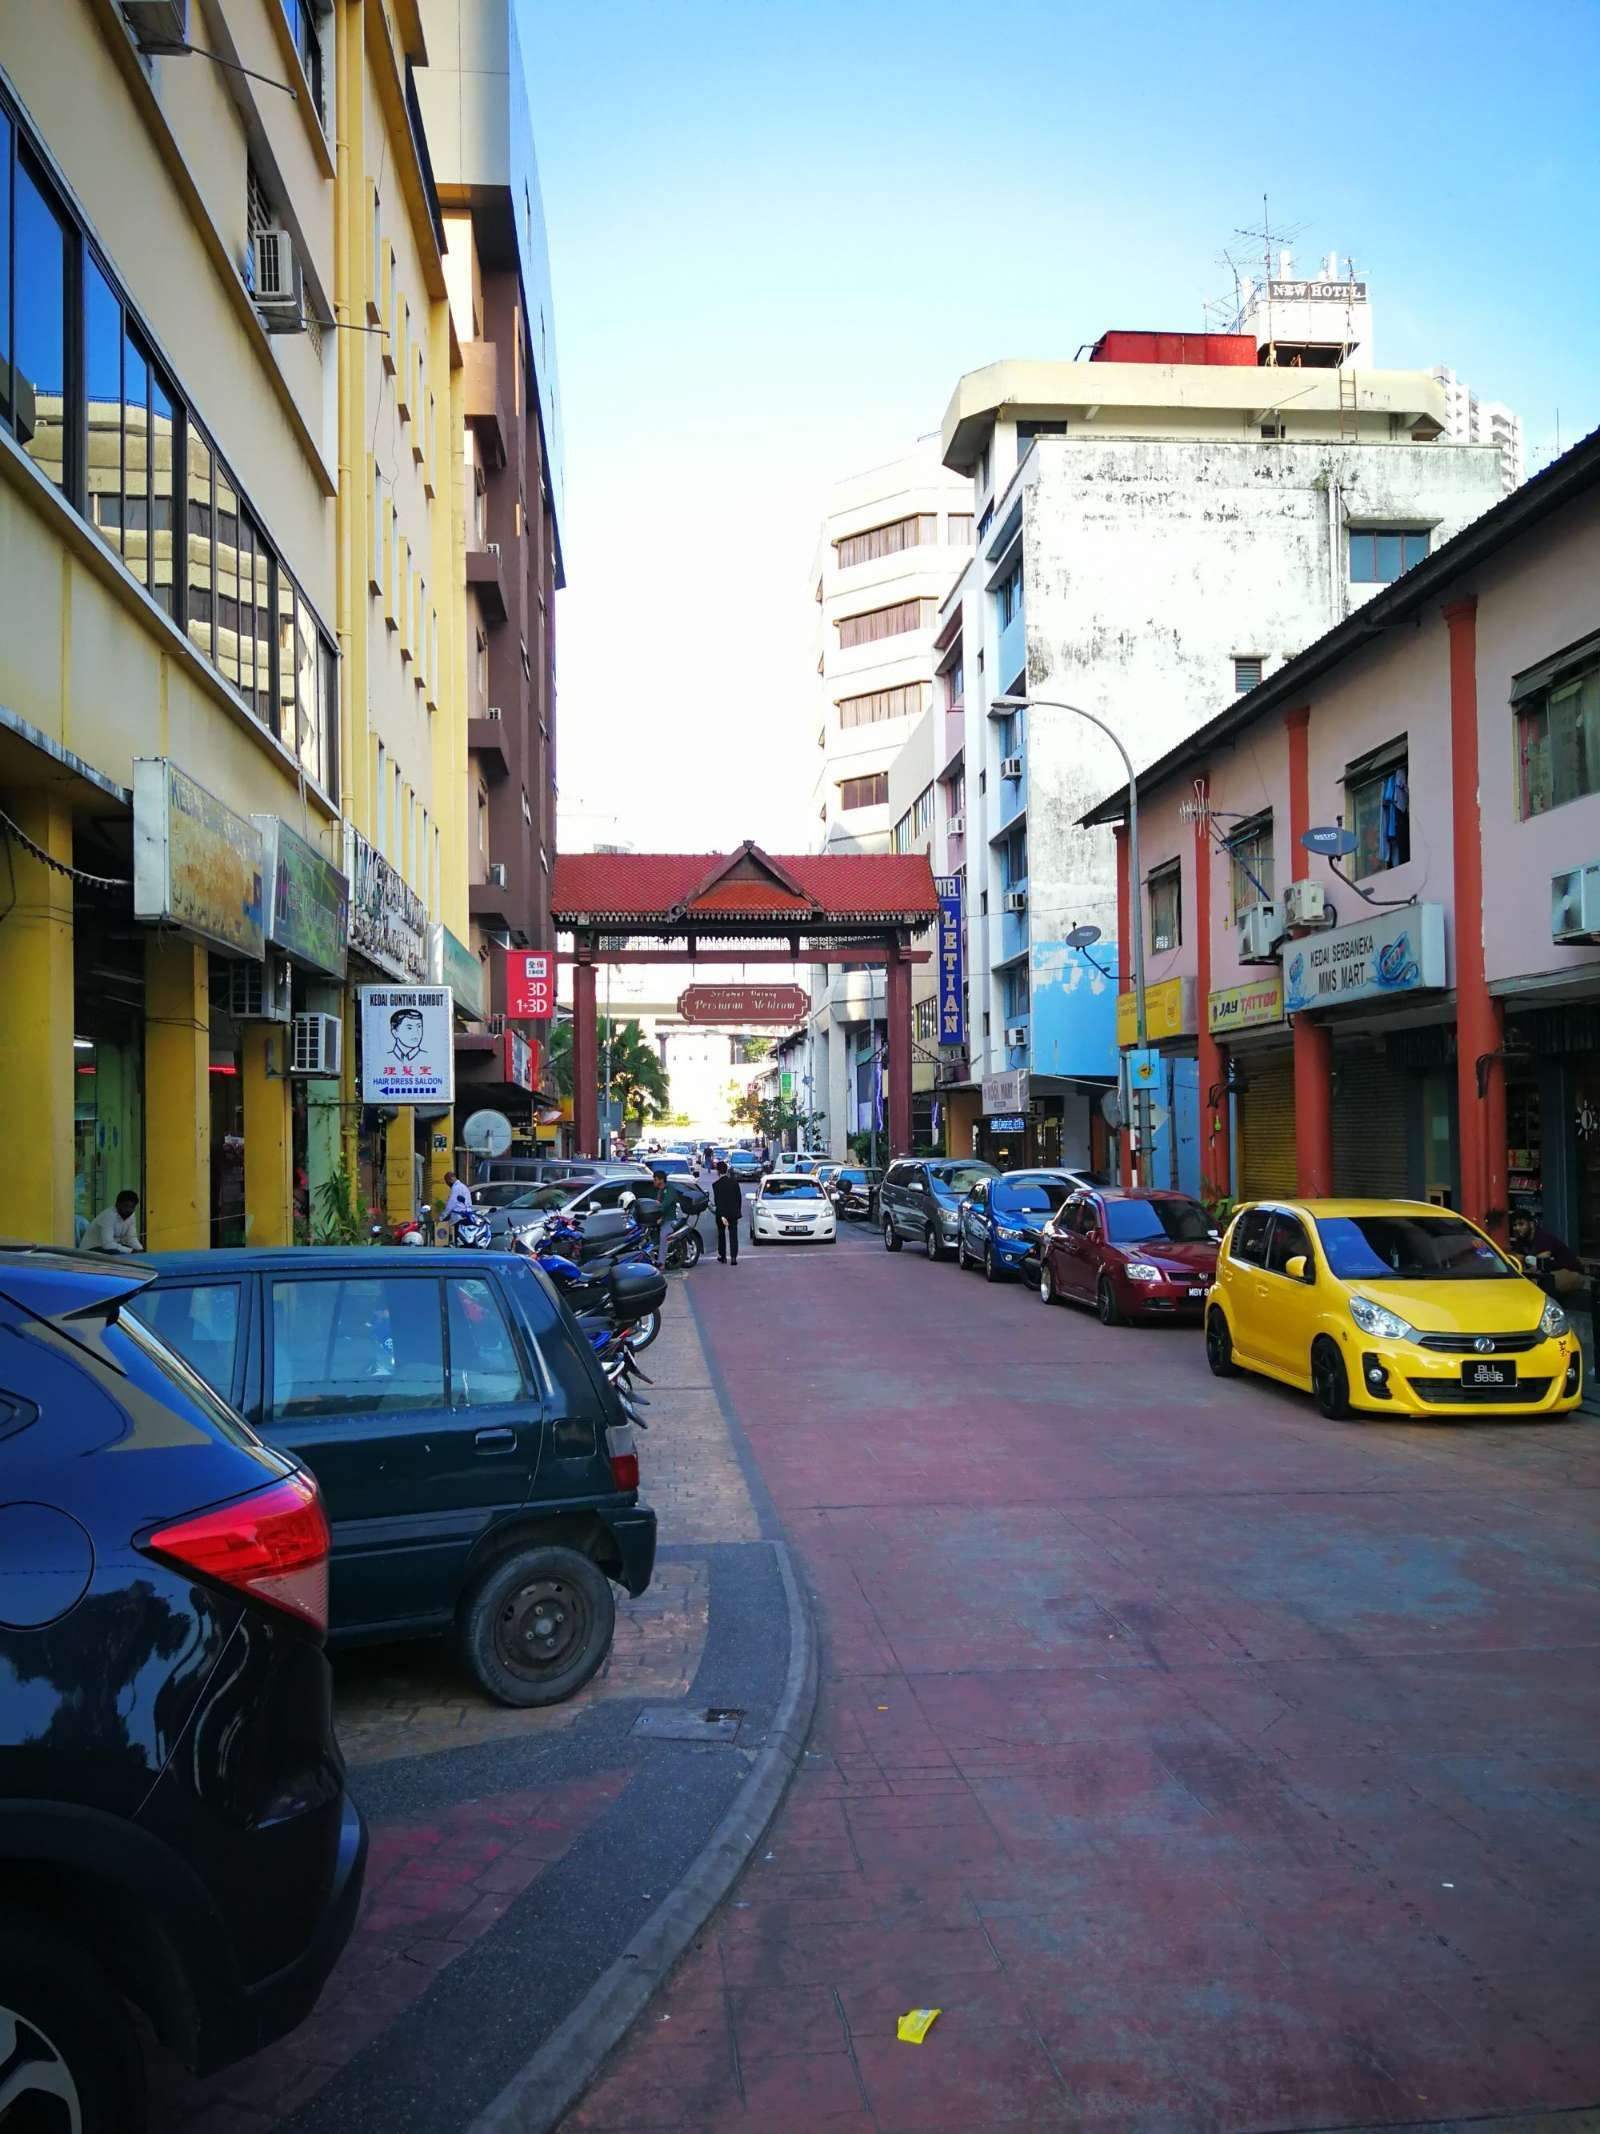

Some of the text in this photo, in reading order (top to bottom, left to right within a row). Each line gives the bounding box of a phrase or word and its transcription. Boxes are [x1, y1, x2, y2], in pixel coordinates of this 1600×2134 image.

[1273, 284, 1307, 297] NEW
[934, 878, 958, 896] OTEL
[1310, 944, 1330, 968] KEDAI
[1332, 935, 1375, 962] SERBANEKA
[943, 911, 959, 1033] LETIAN
[1318, 969, 1337, 993] MMS
[1341, 962, 1366, 988] MART
[528, 982, 547, 996] 3D
[370, 994, 444, 1007] KEDAI GUNTING RAMBUT
[516, 999, 547, 1013] 1+3D
[1219, 999, 1238, 1018] JAY
[373, 1077, 443, 1086] HAIR DRESS SALOON
[1477, 1364, 1500, 1374] BLL
